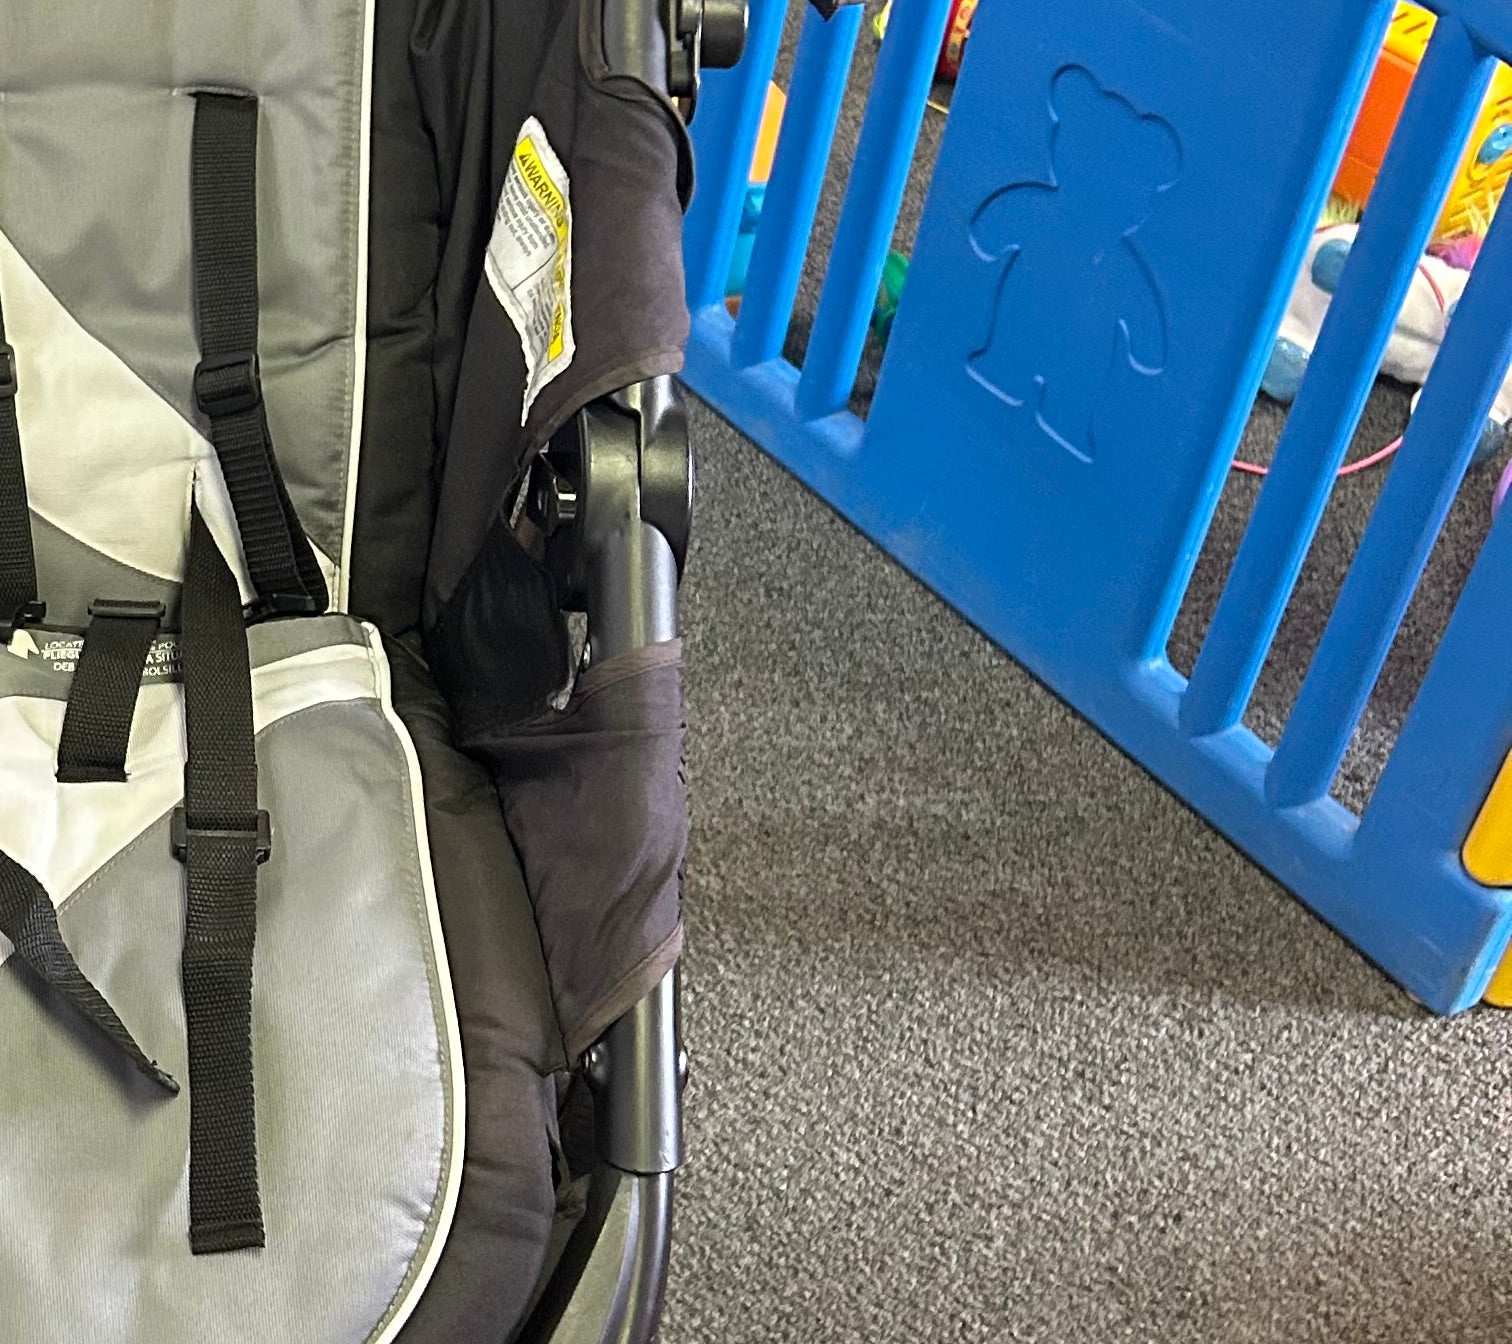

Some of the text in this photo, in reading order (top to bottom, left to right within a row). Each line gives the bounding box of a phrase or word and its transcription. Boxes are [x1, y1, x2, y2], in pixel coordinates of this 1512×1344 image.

[45, 639, 85, 649] LOCATE
[53, 662, 183, 676] DEB BOLSILL
